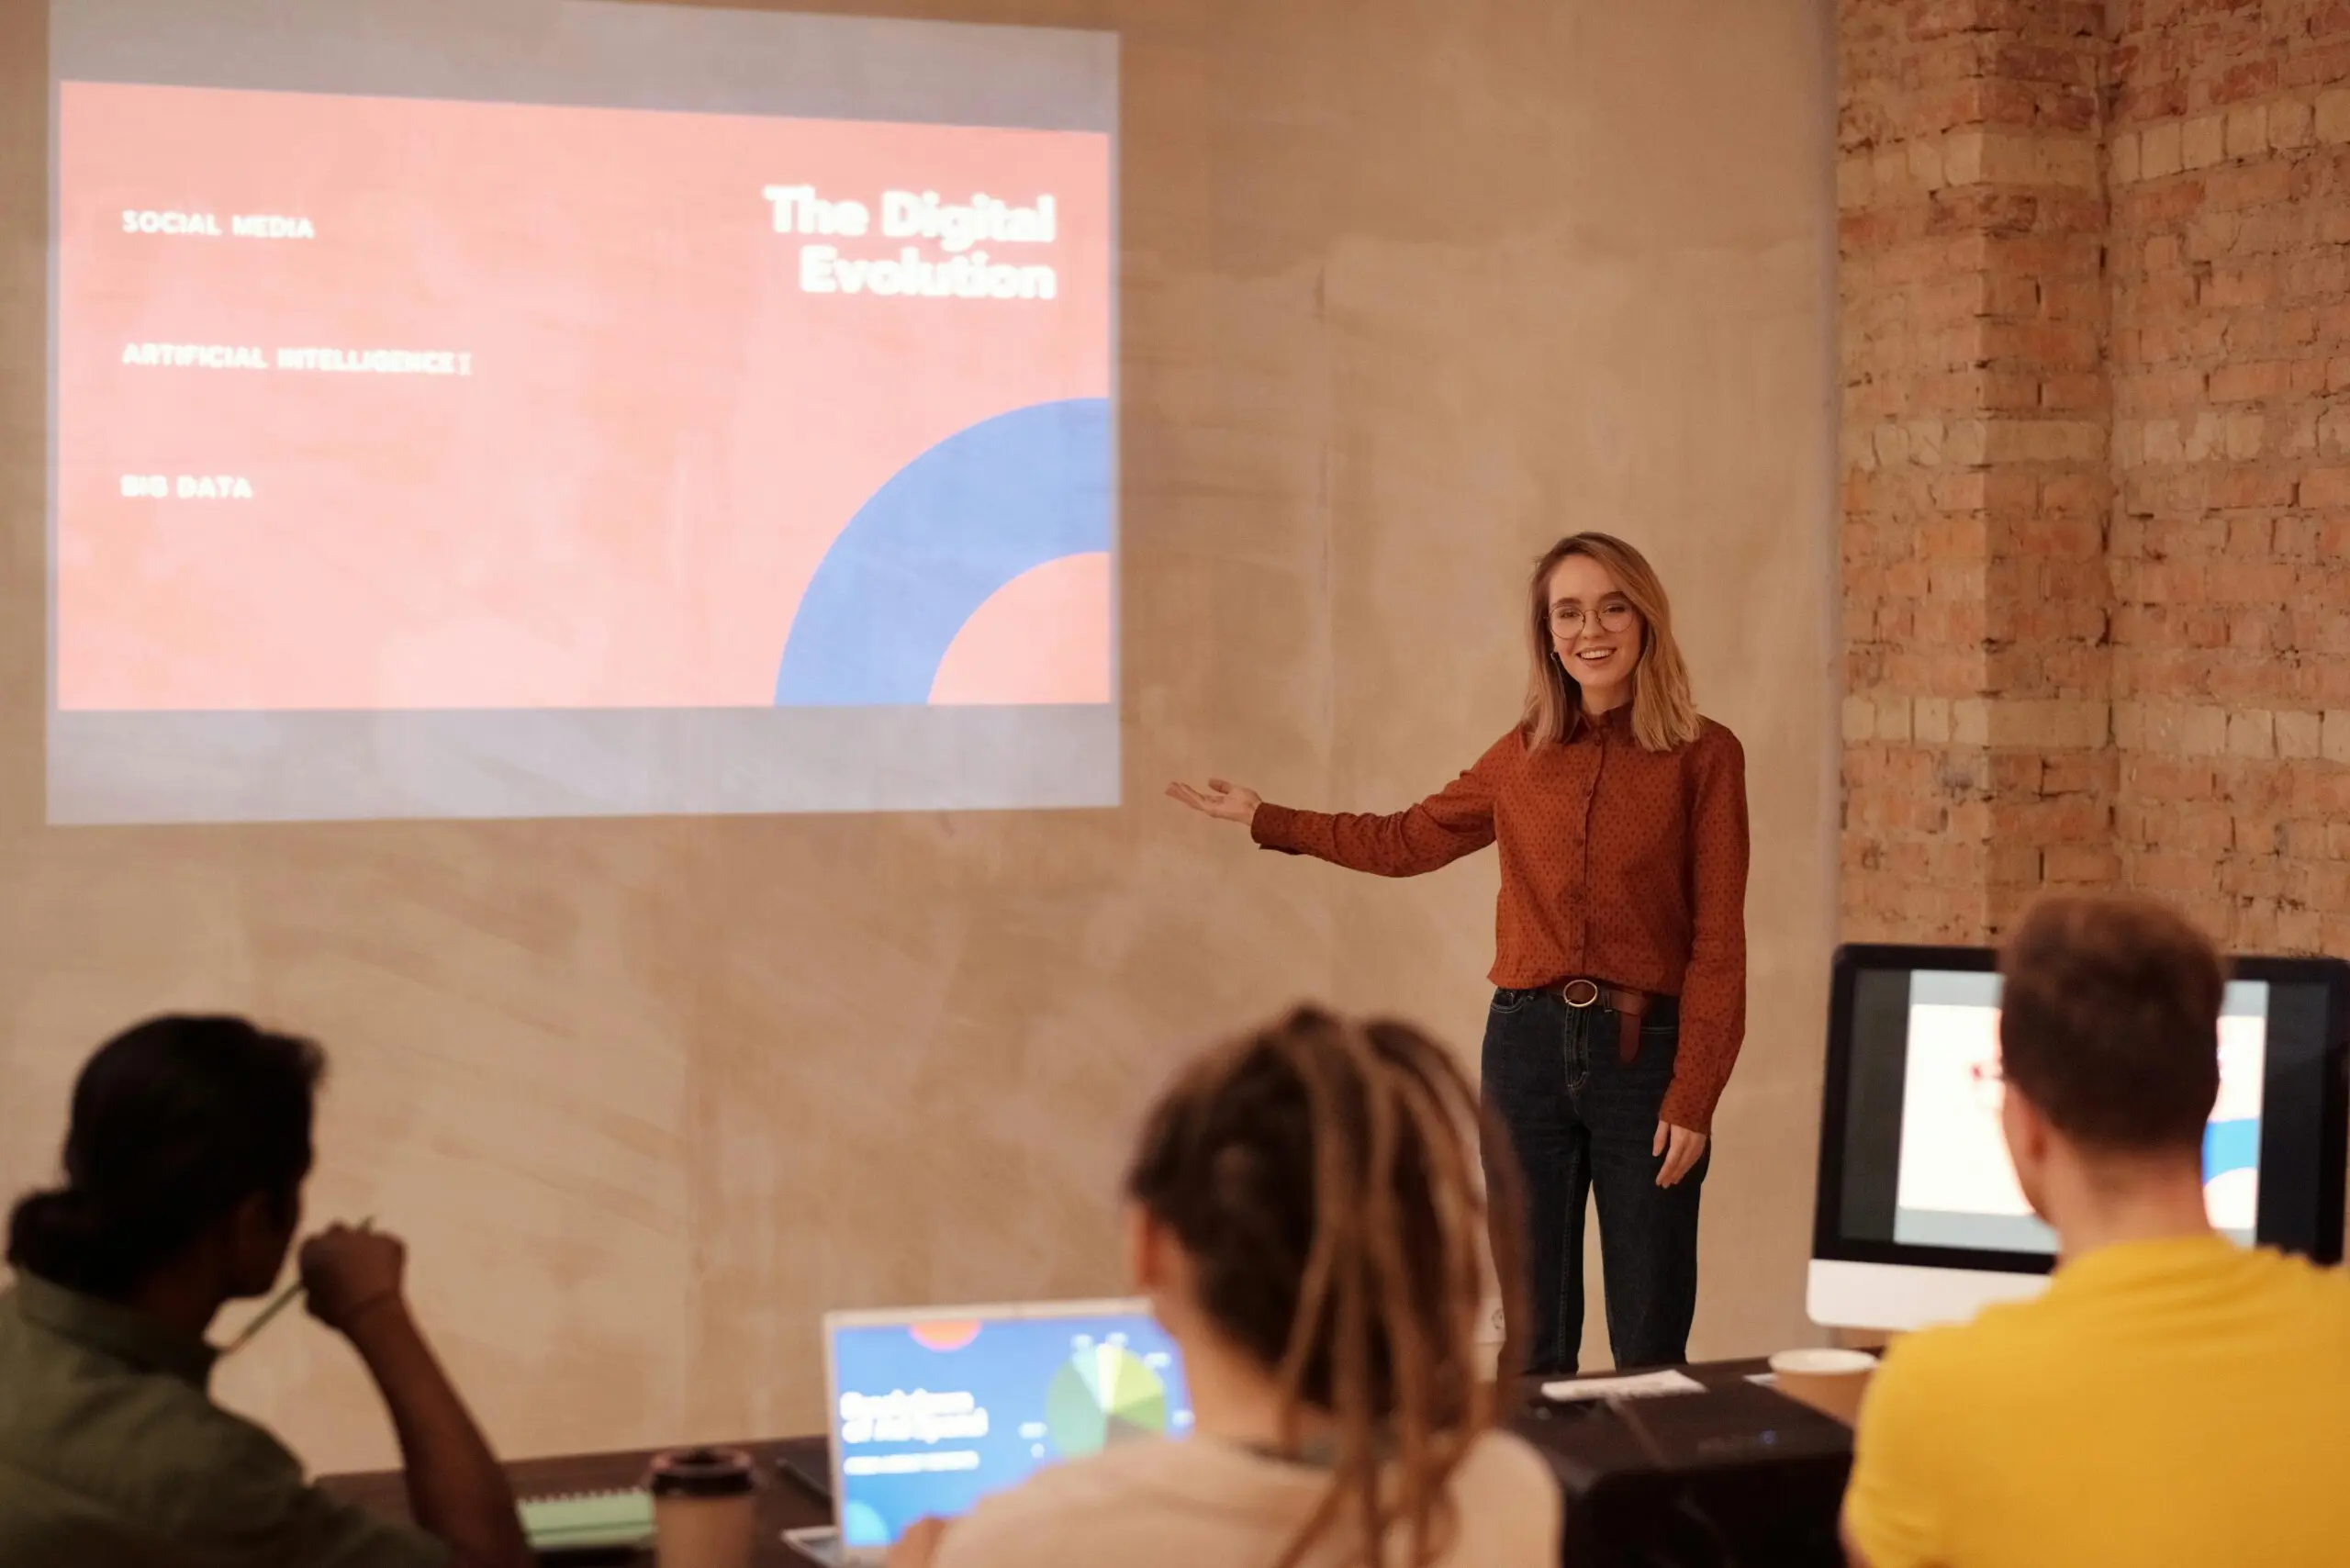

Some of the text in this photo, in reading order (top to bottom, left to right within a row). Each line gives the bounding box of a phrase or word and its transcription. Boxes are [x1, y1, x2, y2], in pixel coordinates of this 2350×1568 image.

[123, 210, 314, 238] SOCIAL MEDIA
[764, 185, 1056, 252] The Digital
[800, 245, 1056, 299] Evolution
[122, 343, 267, 368] ARTIFICIAL
[120, 475, 252, 498] BIG DATA
